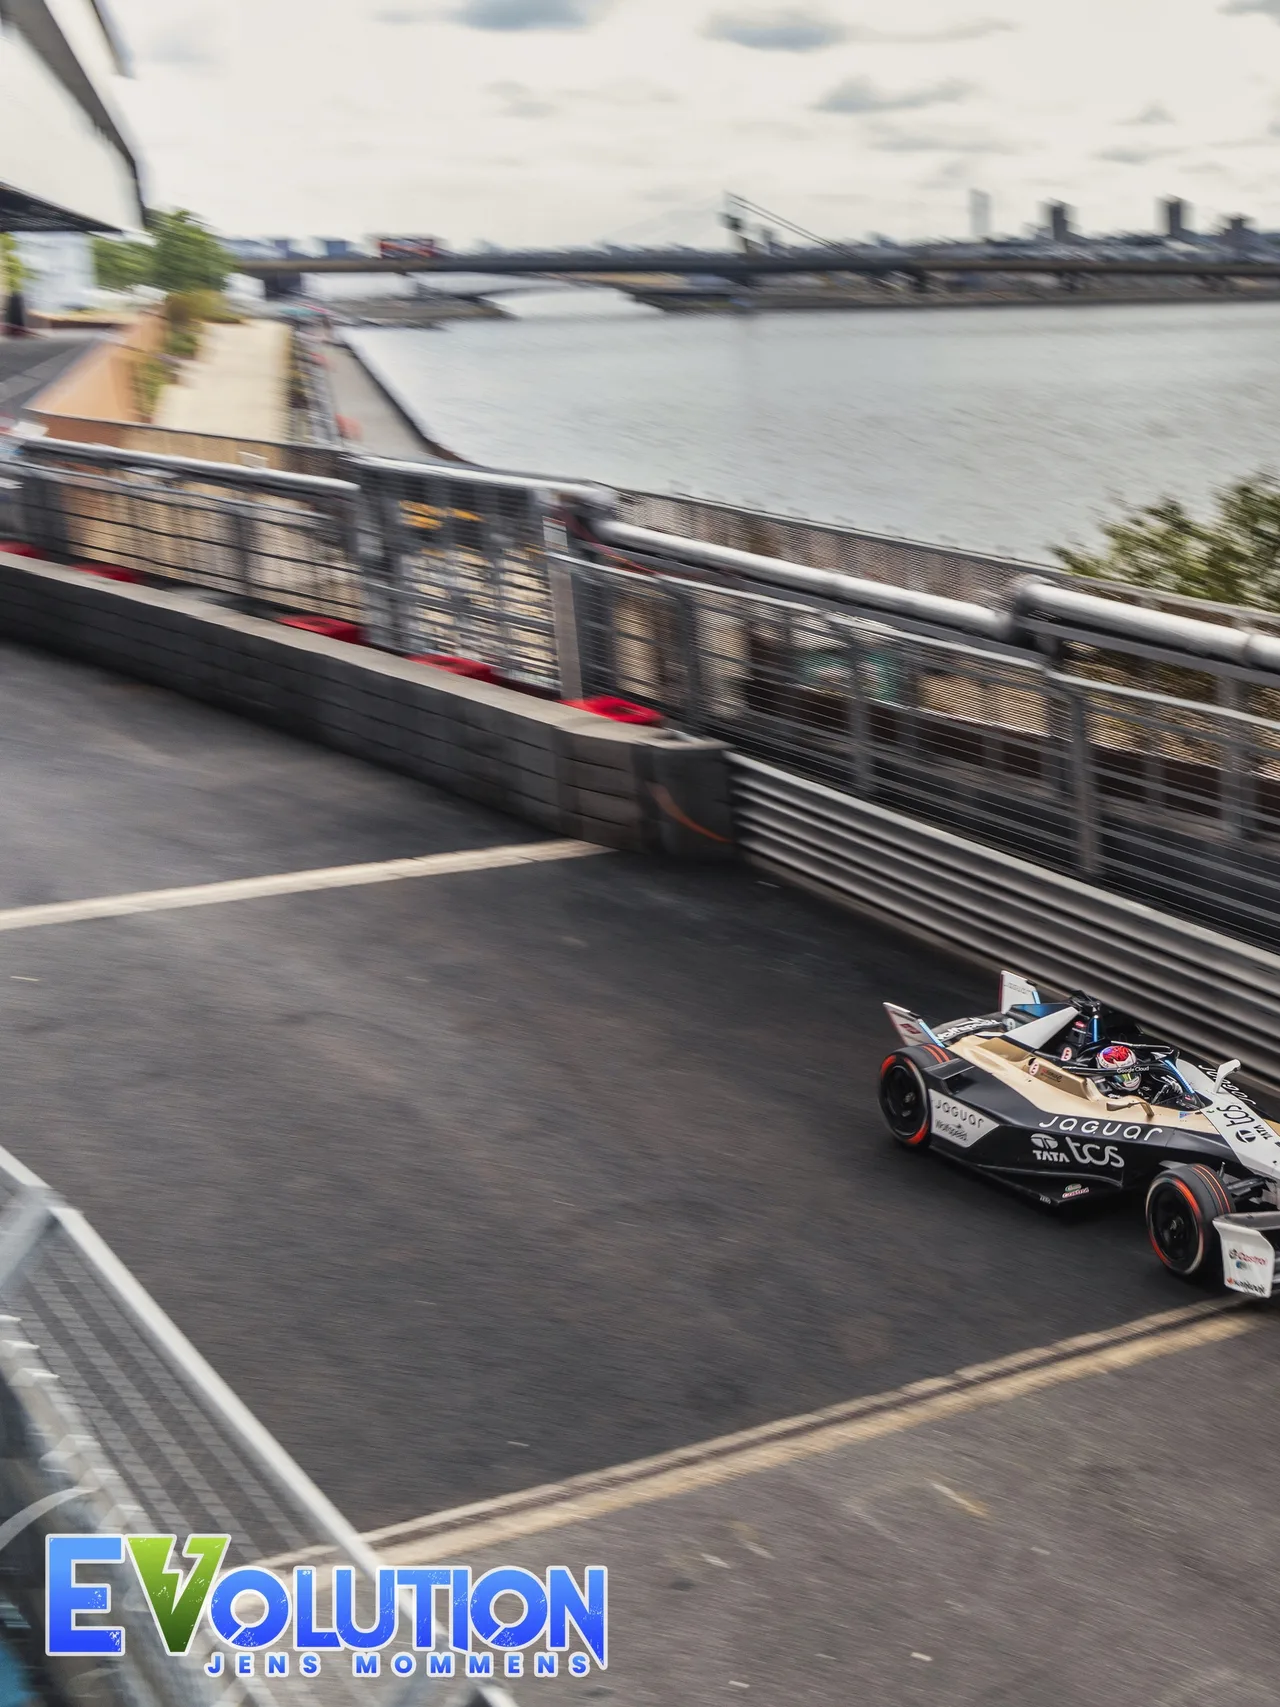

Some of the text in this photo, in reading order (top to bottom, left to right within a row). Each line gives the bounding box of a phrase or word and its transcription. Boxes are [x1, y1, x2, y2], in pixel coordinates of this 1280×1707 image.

[1116, 1066, 1135, 1074] Google
[1032, 1150, 1070, 1162] TATA
[1065, 1136, 1125, 1168] tcs
